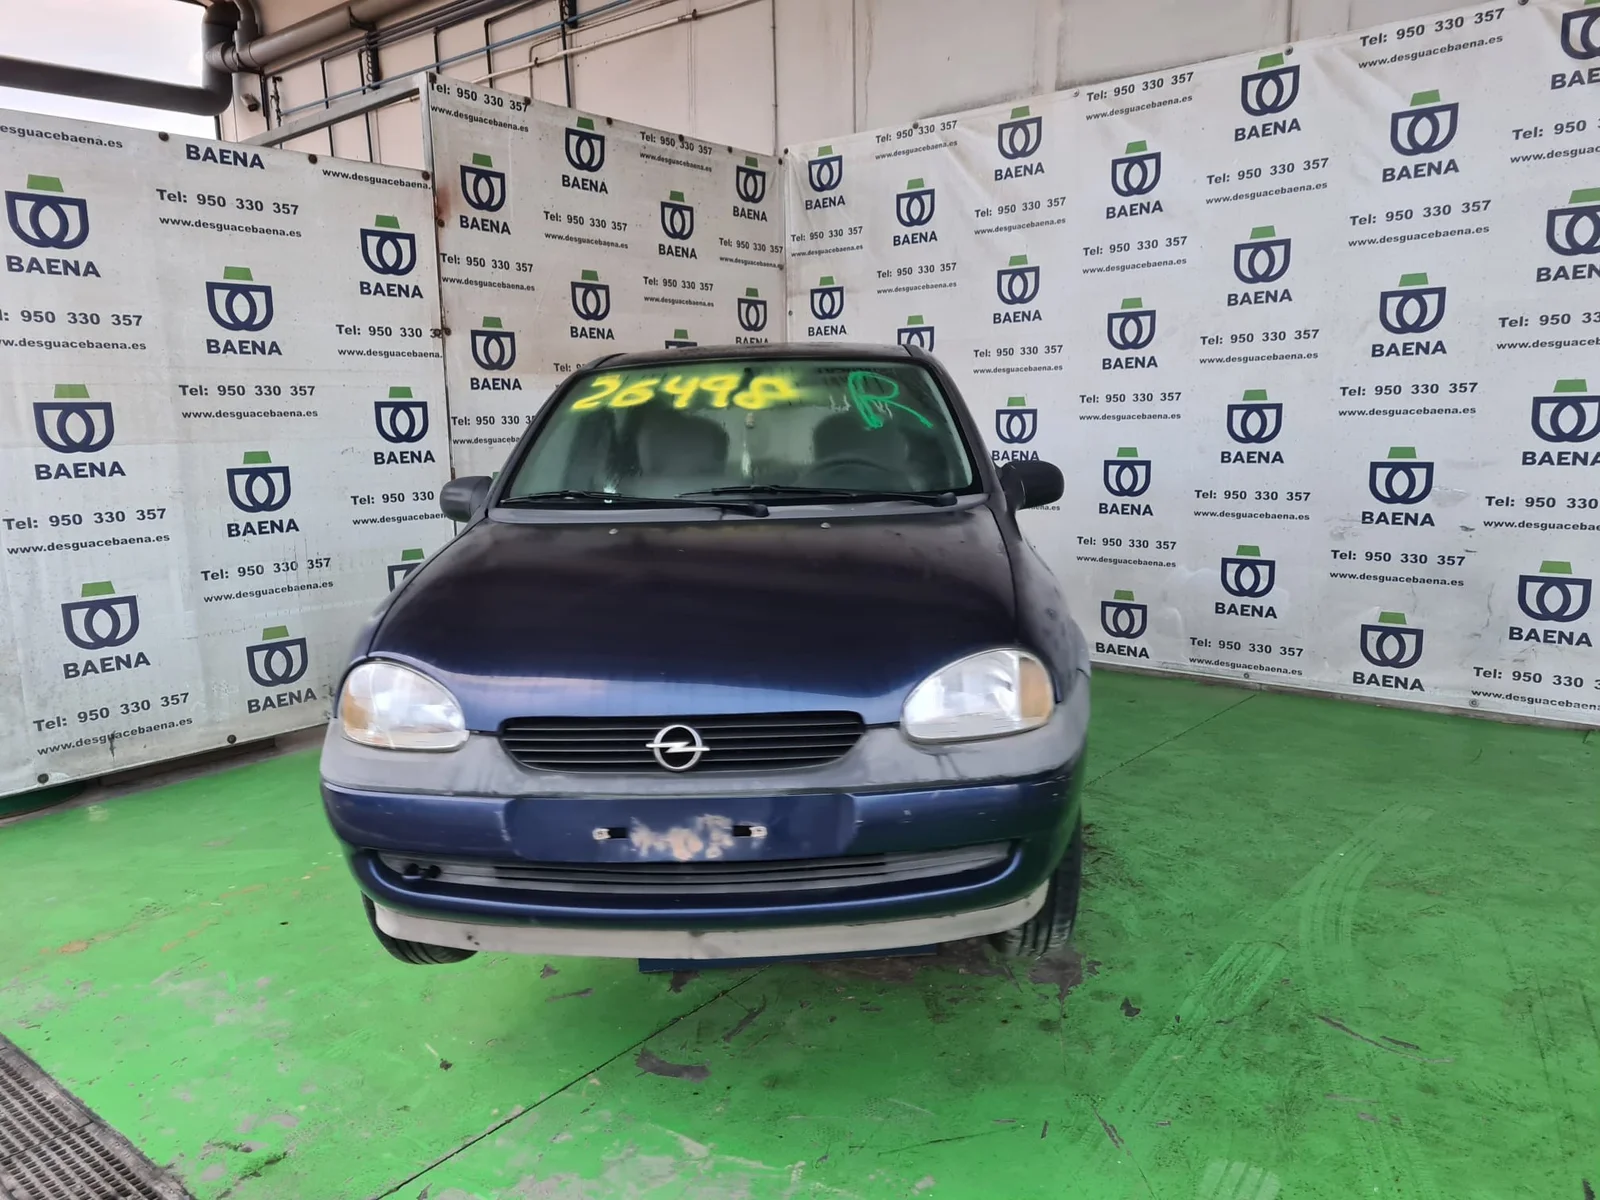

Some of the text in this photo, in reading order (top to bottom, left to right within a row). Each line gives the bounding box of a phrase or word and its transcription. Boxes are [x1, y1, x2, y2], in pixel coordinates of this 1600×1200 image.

[1359, 7, 1505, 47] Tel: 950 330 357
[1358, 35, 1504, 70] www.desguacebaena.es
[1086, 70, 1195, 103] Tel: 950 330 357
[1085, 94, 1193, 122] www.desguacebaena.es
[875, 120, 957, 144] Tel: 950 330 357
[1234, 118, 1301, 142] BAENA
[185, 144, 264, 169] BAENA
[994, 162, 1044, 181] BAENA
[1206, 156, 1330, 186] Tel: 950 330 357
[1381, 159, 1459, 183] BAENA
[561, 175, 608, 194] BAENA
[1205, 182, 1328, 205] www.desguacebaena.es
[155, 187, 299, 216] Tel: 950 330 357
[804, 195, 845, 210] BAENA
[974, 195, 1067, 219] Tel: 950 330 357
[1105, 200, 1163, 219] BAENA
[542, 210, 628, 233] Tel: 950 330 357
[732, 206, 767, 222] BAENA
[1349, 199, 1492, 227] Tel: 950 330 357
[158, 216, 302, 238] www.desguacebaena.es
[459, 215, 511, 235] BAENA
[790, 225, 864, 243] Tel: 950 330 357
[892, 230, 937, 246] BAENA
[1082, 235, 1188, 257] Tel: 950 330 357
[1347, 226, 1490, 248] www.desguacebaena.es
[658, 243, 697, 259] BAENA
[5, 255, 101, 278] BAENA
[440, 252, 534, 273] Tel: 950 330 357
[876, 261, 957, 280] Tel: 950 330 357
[1082, 258, 1187, 275] www.desguacebaena.es
[359, 281, 423, 298] BAENA
[642, 275, 714, 292] Tel: 950 330 357
[1227, 289, 1292, 307] BAENA
[992, 310, 1042, 324] BAENA
[569, 326, 614, 340] BAENA
[807, 324, 846, 336] BAENA
[1199, 328, 1320, 346] Tel: 950 330 357
[205, 338, 282, 355] BAENA
[973, 343, 1064, 358] Tel: 950 330 357
[1371, 340, 1447, 357] BAENA
[1101, 356, 1158, 370] BAENA
[1199, 352, 1319, 365] www.desguacebaena.es
[470, 377, 522, 391] BAENA
[1339, 381, 1479, 397] Tel: 950 330 357
[848, 371, 934, 430] R
[181, 409, 319, 420] www.desguacebaena.es
[1078, 412, 1182, 422] www.desguacebaena.es
[1338, 406, 1477, 418] www.desguacebaena.es
[373, 450, 435, 465] BAENA
[1220, 451, 1284, 464] BAENA
[1521, 451, 1600, 466] BAENA
[34, 461, 126, 480] BAENA
[350, 490, 435, 506] Tel: 950 330
[1484, 495, 1599, 510] Tel: 950 330
[2, 507, 167, 531] Tel: 950 330 357
[1098, 503, 1153, 516] BAENA
[1193, 509, 1310, 521] www.desguacebaena.es
[1361, 511, 1435, 526] BAENA
[226, 519, 299, 537] BAENA
[6, 534, 171, 555] www.desguacebaena.es
[1076, 535, 1177, 550] Tel: 950 330 357
[1076, 555, 1177, 568] www.desguacebaena.es
[1330, 548, 1466, 567] Tel: 950 330 357
[200, 556, 332, 582] Tel: 950 330 357
[1329, 572, 1465, 587] www.desguacebaena.es
[203, 580, 334, 603] www.desguacebaena.es
[1214, 602, 1277, 618] BAENA
[1508, 626, 1592, 647] BAENA
[1095, 642, 1149, 659] BAENA
[1189, 636, 1304, 658] Tel: 950 330 357
[62, 652, 150, 679] BAENA
[1188, 657, 1303, 677] www.desguacebaena.es
[1352, 671, 1424, 692] BAENA
[247, 688, 317, 713] BAENA
[32, 691, 190, 732] Tel: 950 330 357
